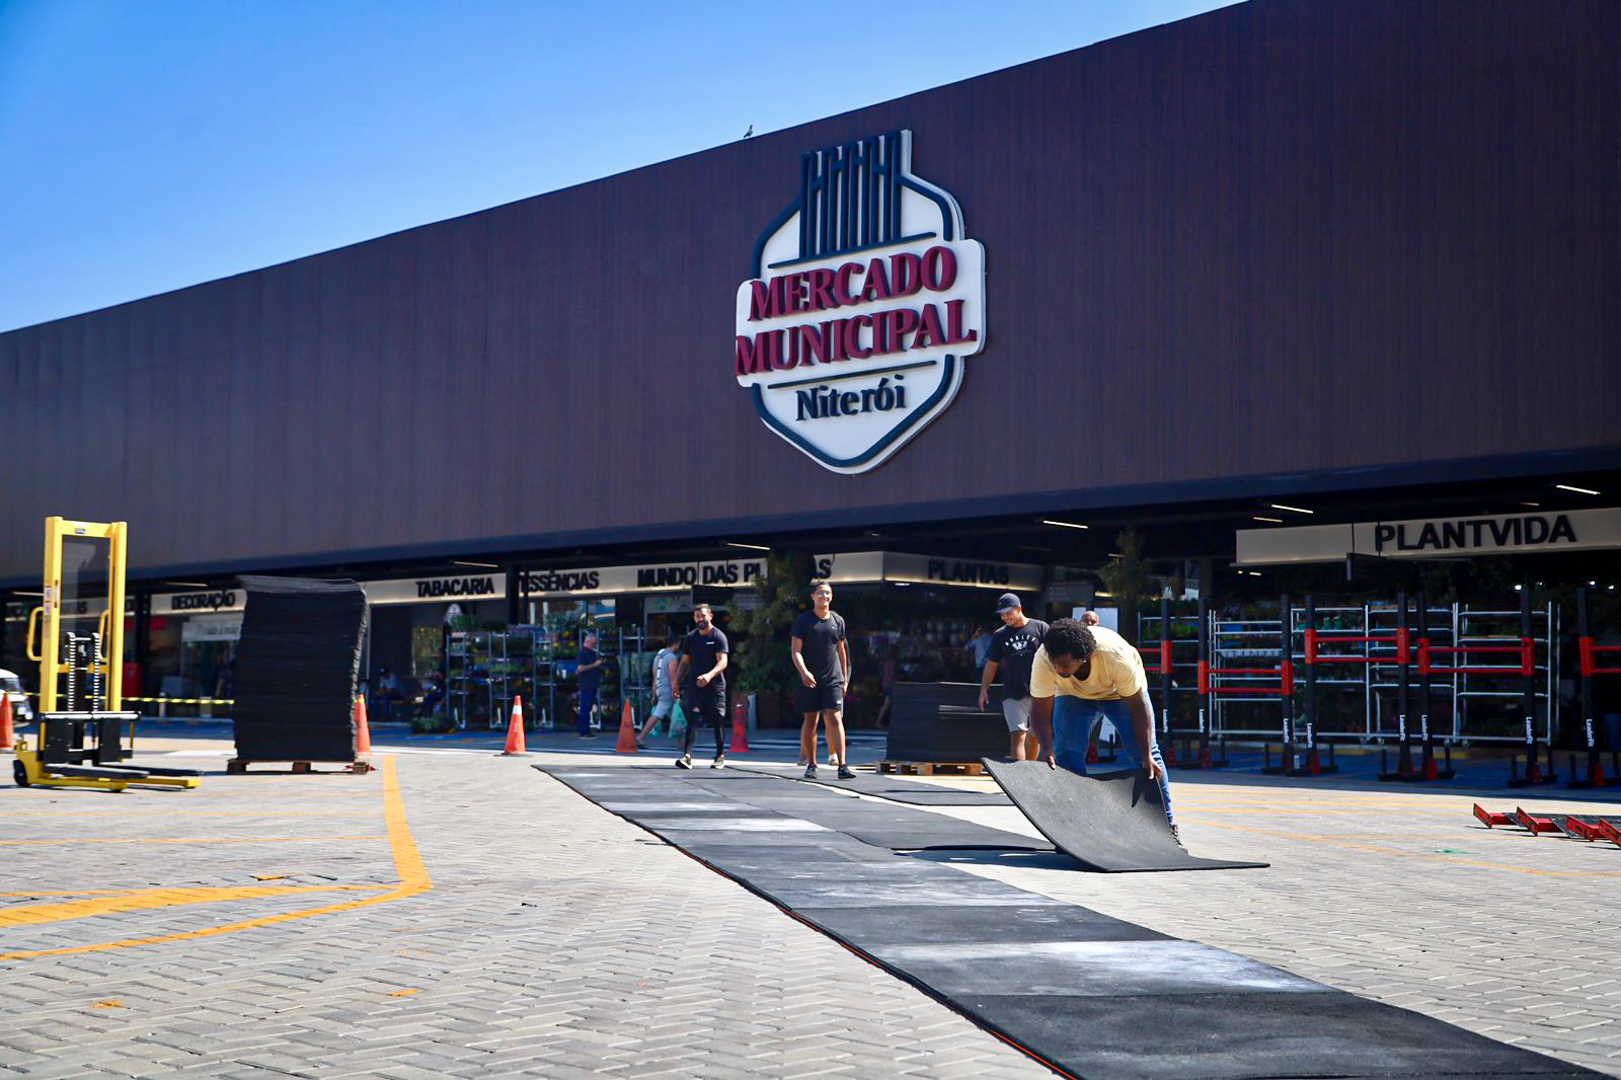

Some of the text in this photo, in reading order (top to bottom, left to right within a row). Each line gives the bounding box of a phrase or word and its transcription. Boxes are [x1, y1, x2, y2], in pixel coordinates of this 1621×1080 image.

[748, 246, 957, 321] MERCADO
[734, 300, 977, 376] MUNICIPAL
[796, 374, 906, 421] Niterói
[1375, 514, 1577, 552] PLANTVIDA
[417, 577, 495, 598] TABACARIA
[638, 566, 697, 588] MUNDO
[702, 563, 738, 585] DAS
[928, 558, 1011, 585] PLANTAS
[172, 590, 236, 611] DECORAÇÃO
